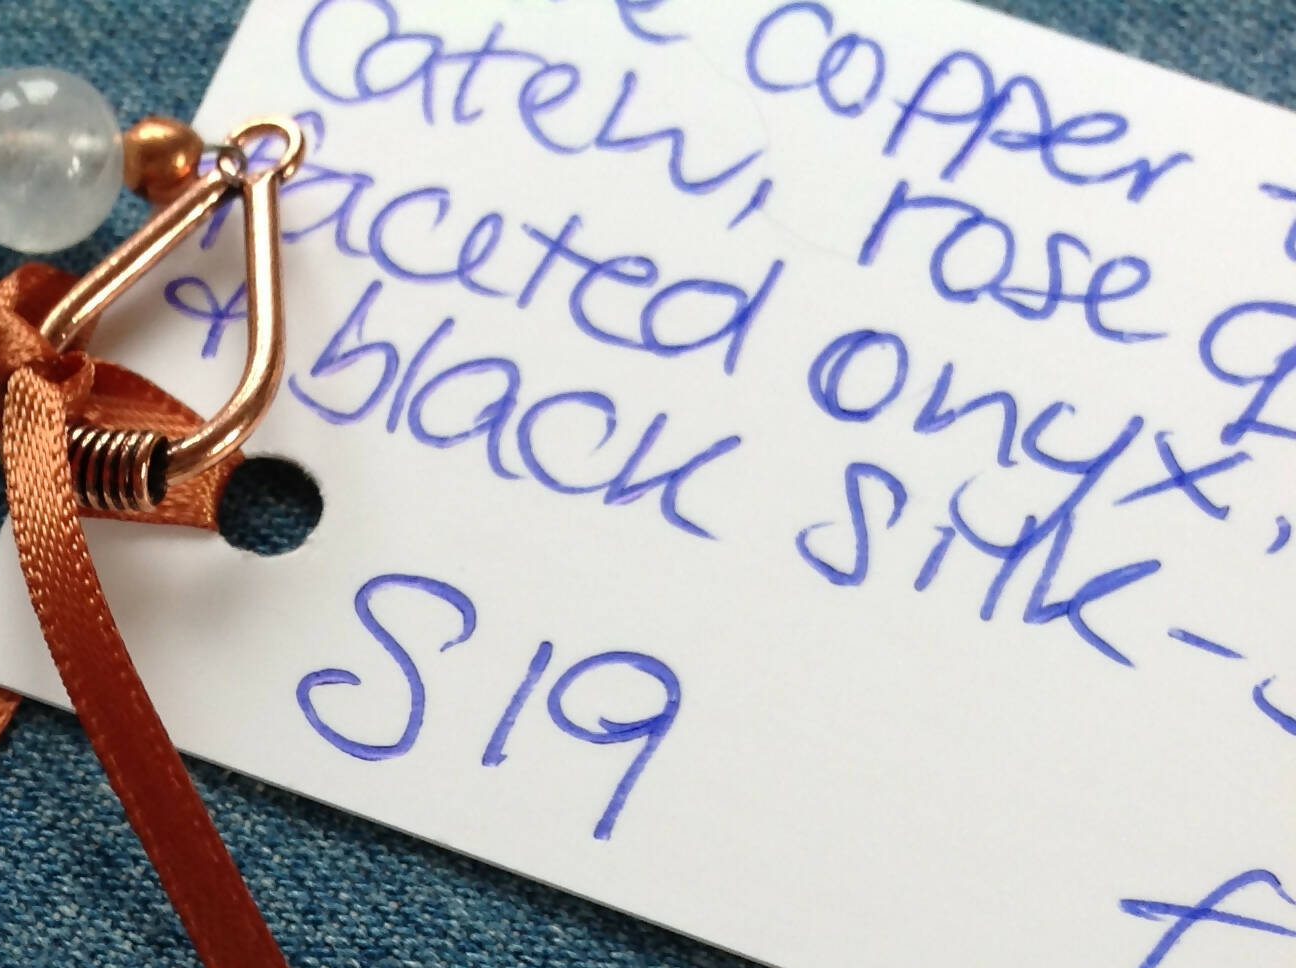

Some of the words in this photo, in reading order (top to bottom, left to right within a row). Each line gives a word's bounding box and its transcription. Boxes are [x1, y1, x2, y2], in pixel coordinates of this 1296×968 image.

[745, 1, 1195, 203] copper
[856, 177, 1169, 343] rose
[287, 279, 742, 541] black
